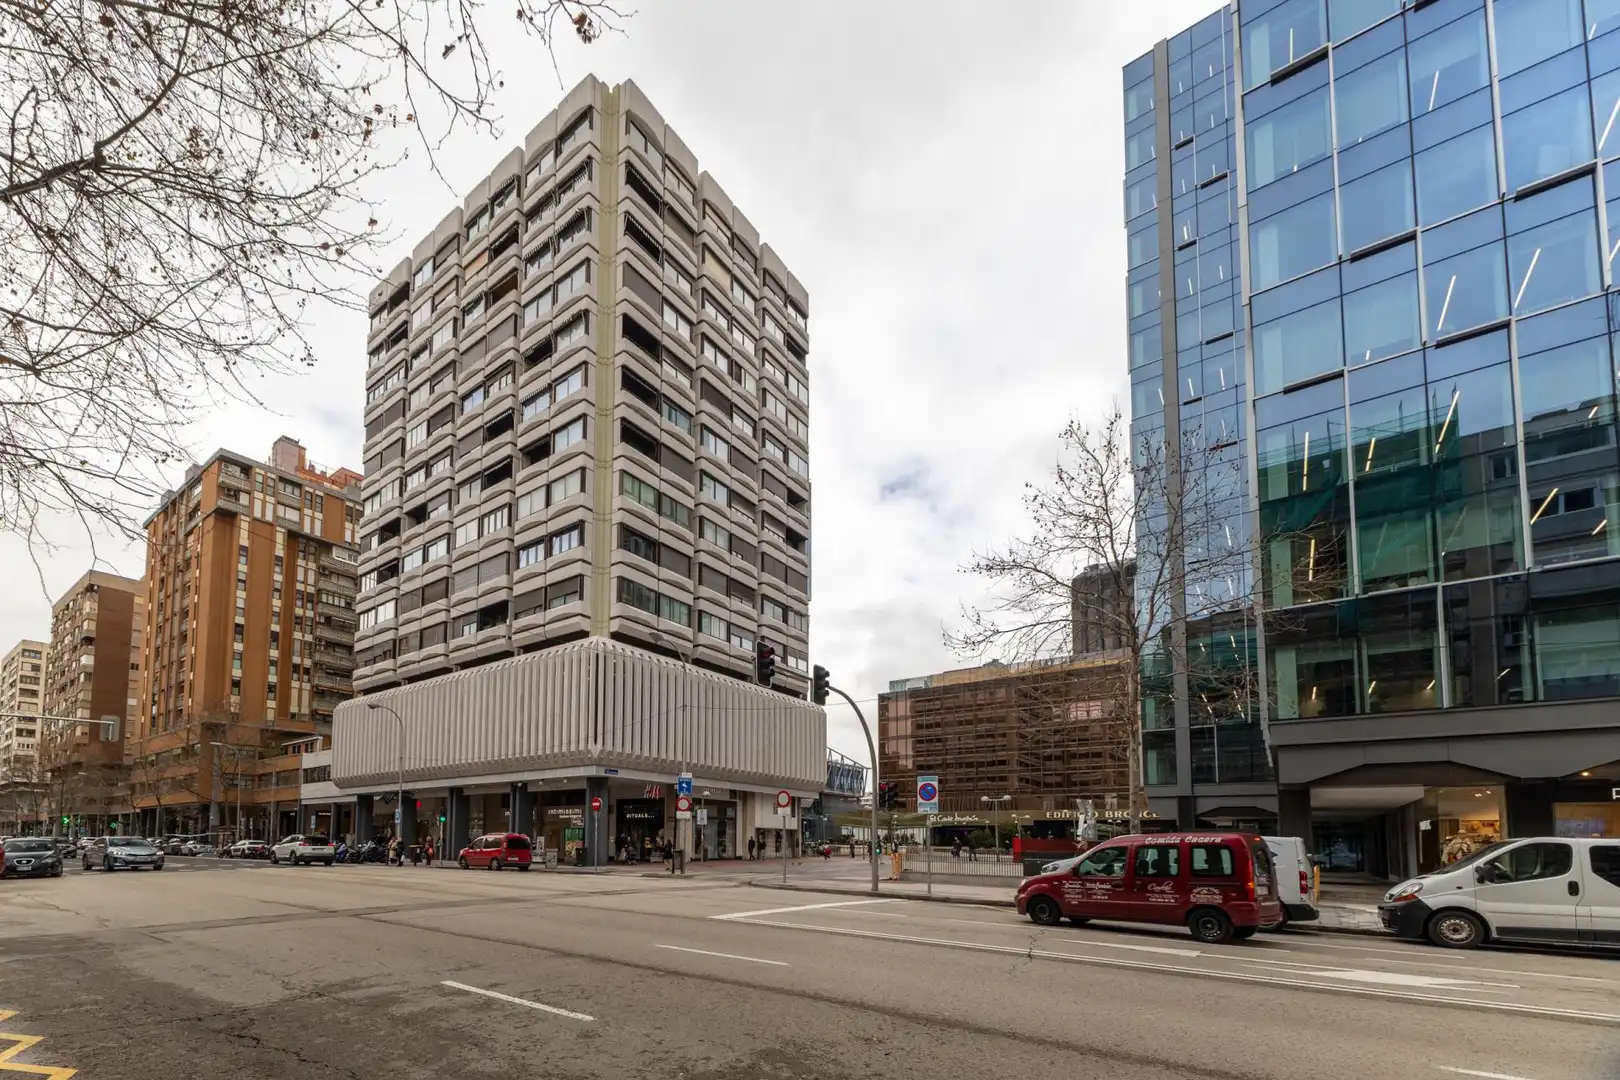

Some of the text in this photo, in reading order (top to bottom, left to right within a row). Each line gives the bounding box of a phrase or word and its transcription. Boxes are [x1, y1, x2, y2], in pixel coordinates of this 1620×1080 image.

[1046, 810, 1160, 819] EDIFICO BROC
[1145, 836, 1180, 844] Comida
